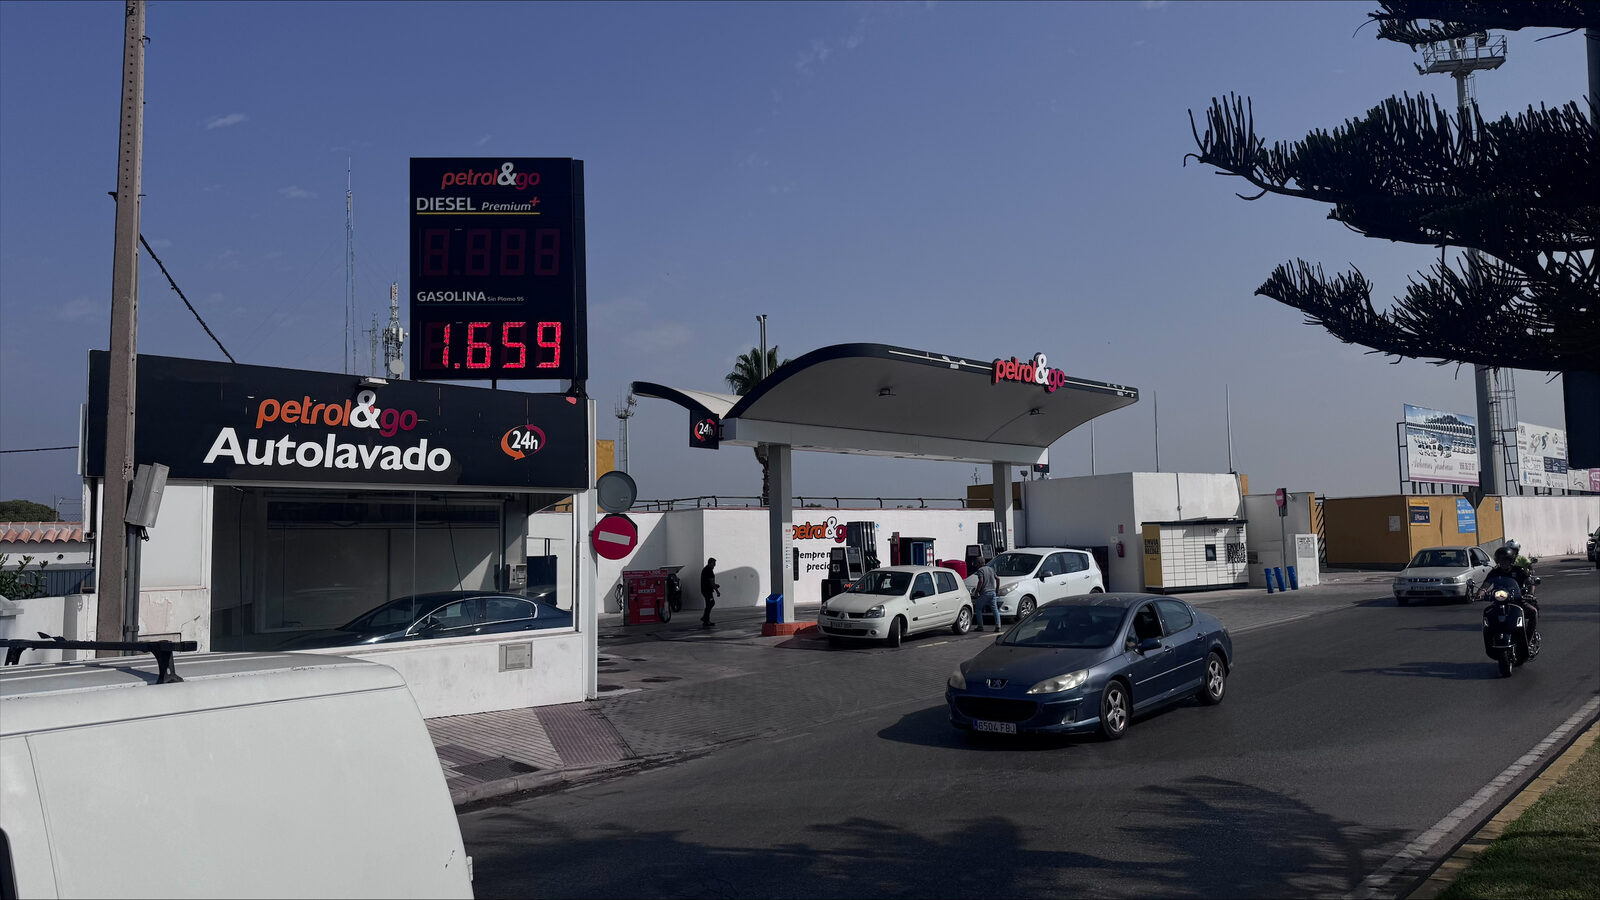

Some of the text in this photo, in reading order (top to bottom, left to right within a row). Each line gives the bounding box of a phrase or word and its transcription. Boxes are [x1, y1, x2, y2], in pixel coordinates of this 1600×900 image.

[441, 162, 541, 190] petrol&go
[416, 197, 477, 211] DIESEL
[416, 291, 487, 302] GASOLINA
[442, 321, 562, 369] 1.659
[992, 352, 1066, 393] petrol&go
[255, 389, 418, 438] petrol&go
[203, 427, 452, 472] Autolavado
[511, 430, 539, 451] 24h
